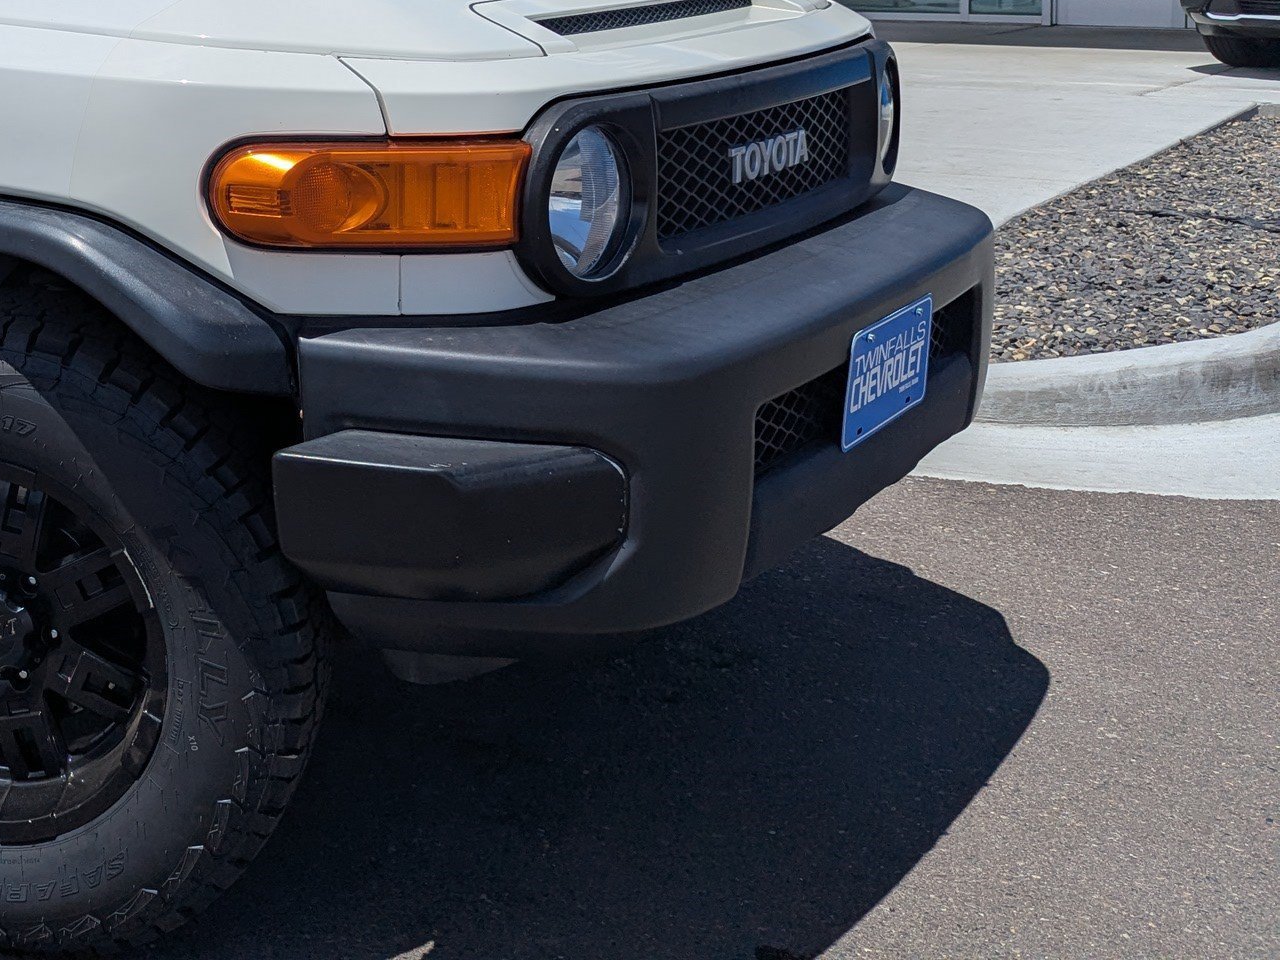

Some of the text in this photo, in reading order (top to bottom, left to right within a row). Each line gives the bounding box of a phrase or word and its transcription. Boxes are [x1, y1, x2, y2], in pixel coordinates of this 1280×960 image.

[728, 129, 809, 184] TOYOTA
[855, 320, 927, 376] TWINFALLS
[849, 340, 925, 414] CHEVROLET
